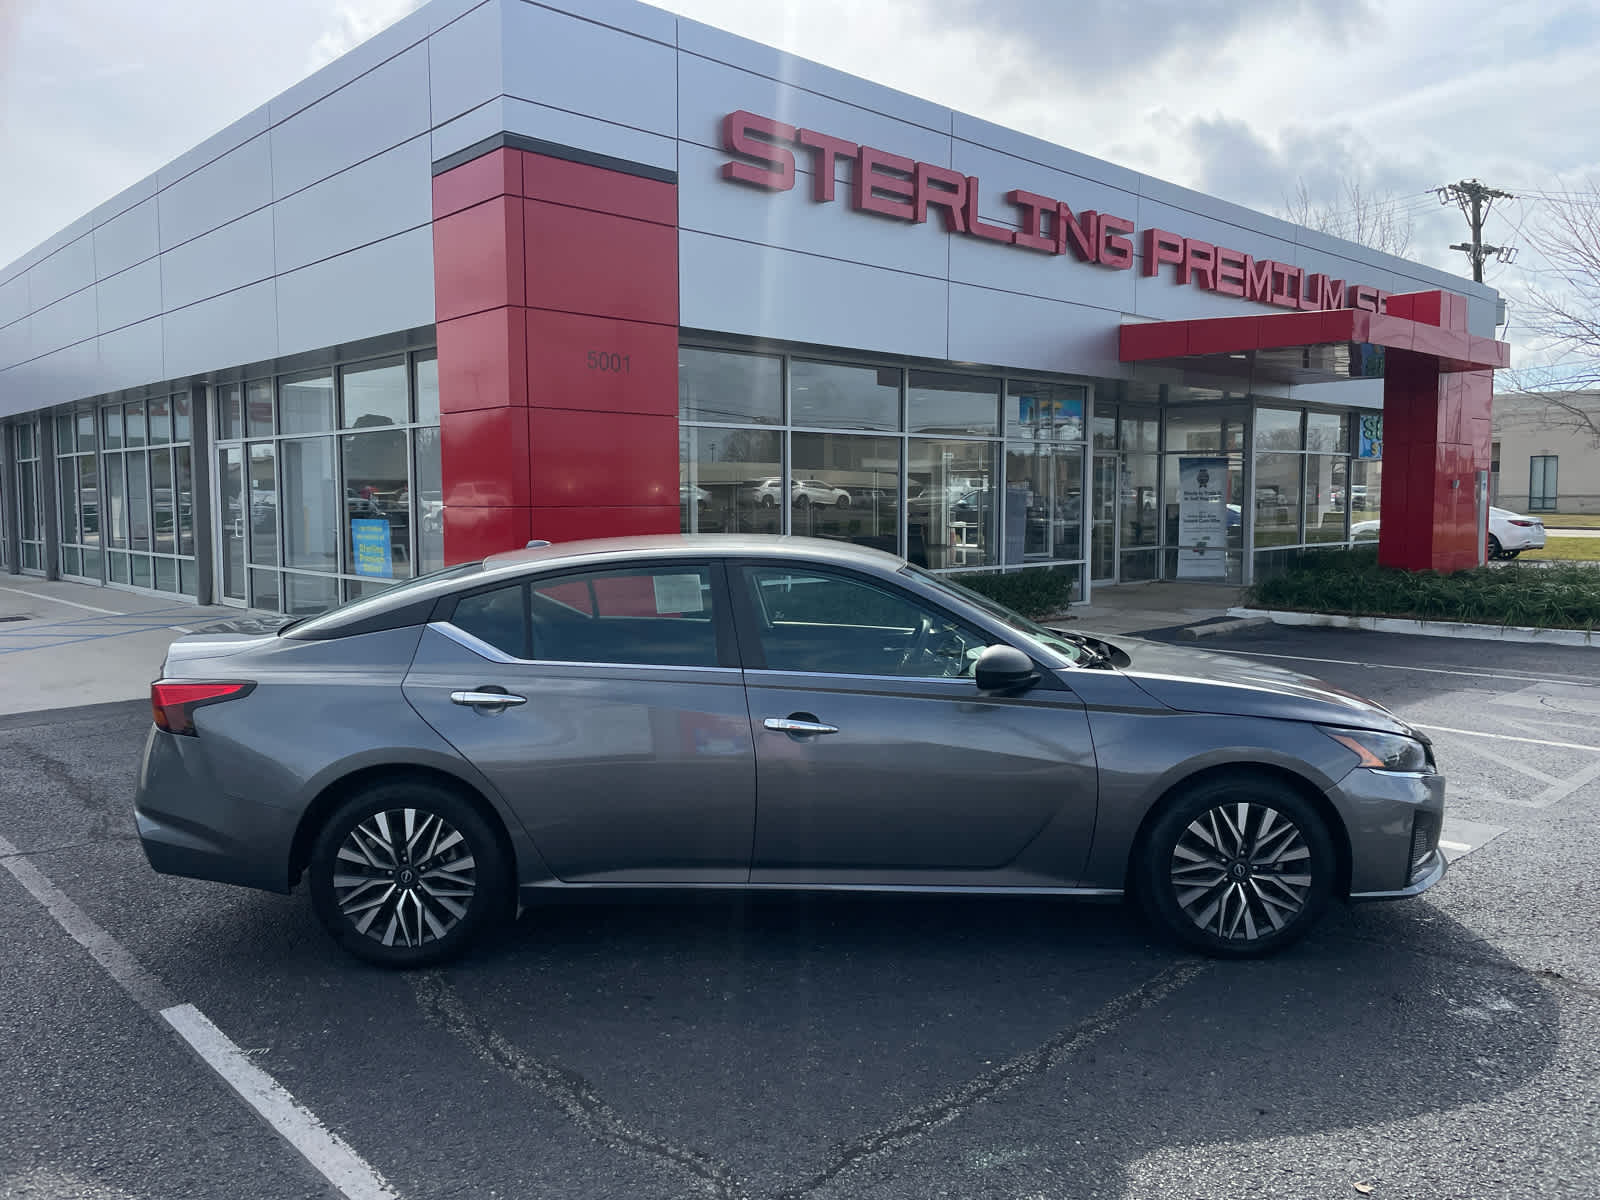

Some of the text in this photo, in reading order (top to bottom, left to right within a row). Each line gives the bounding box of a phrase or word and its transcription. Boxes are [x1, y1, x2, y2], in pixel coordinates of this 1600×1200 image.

[721, 109, 1135, 271] STERLING
[1143, 227, 1346, 312] PREMIUM
[587, 351, 631, 375] 5001
